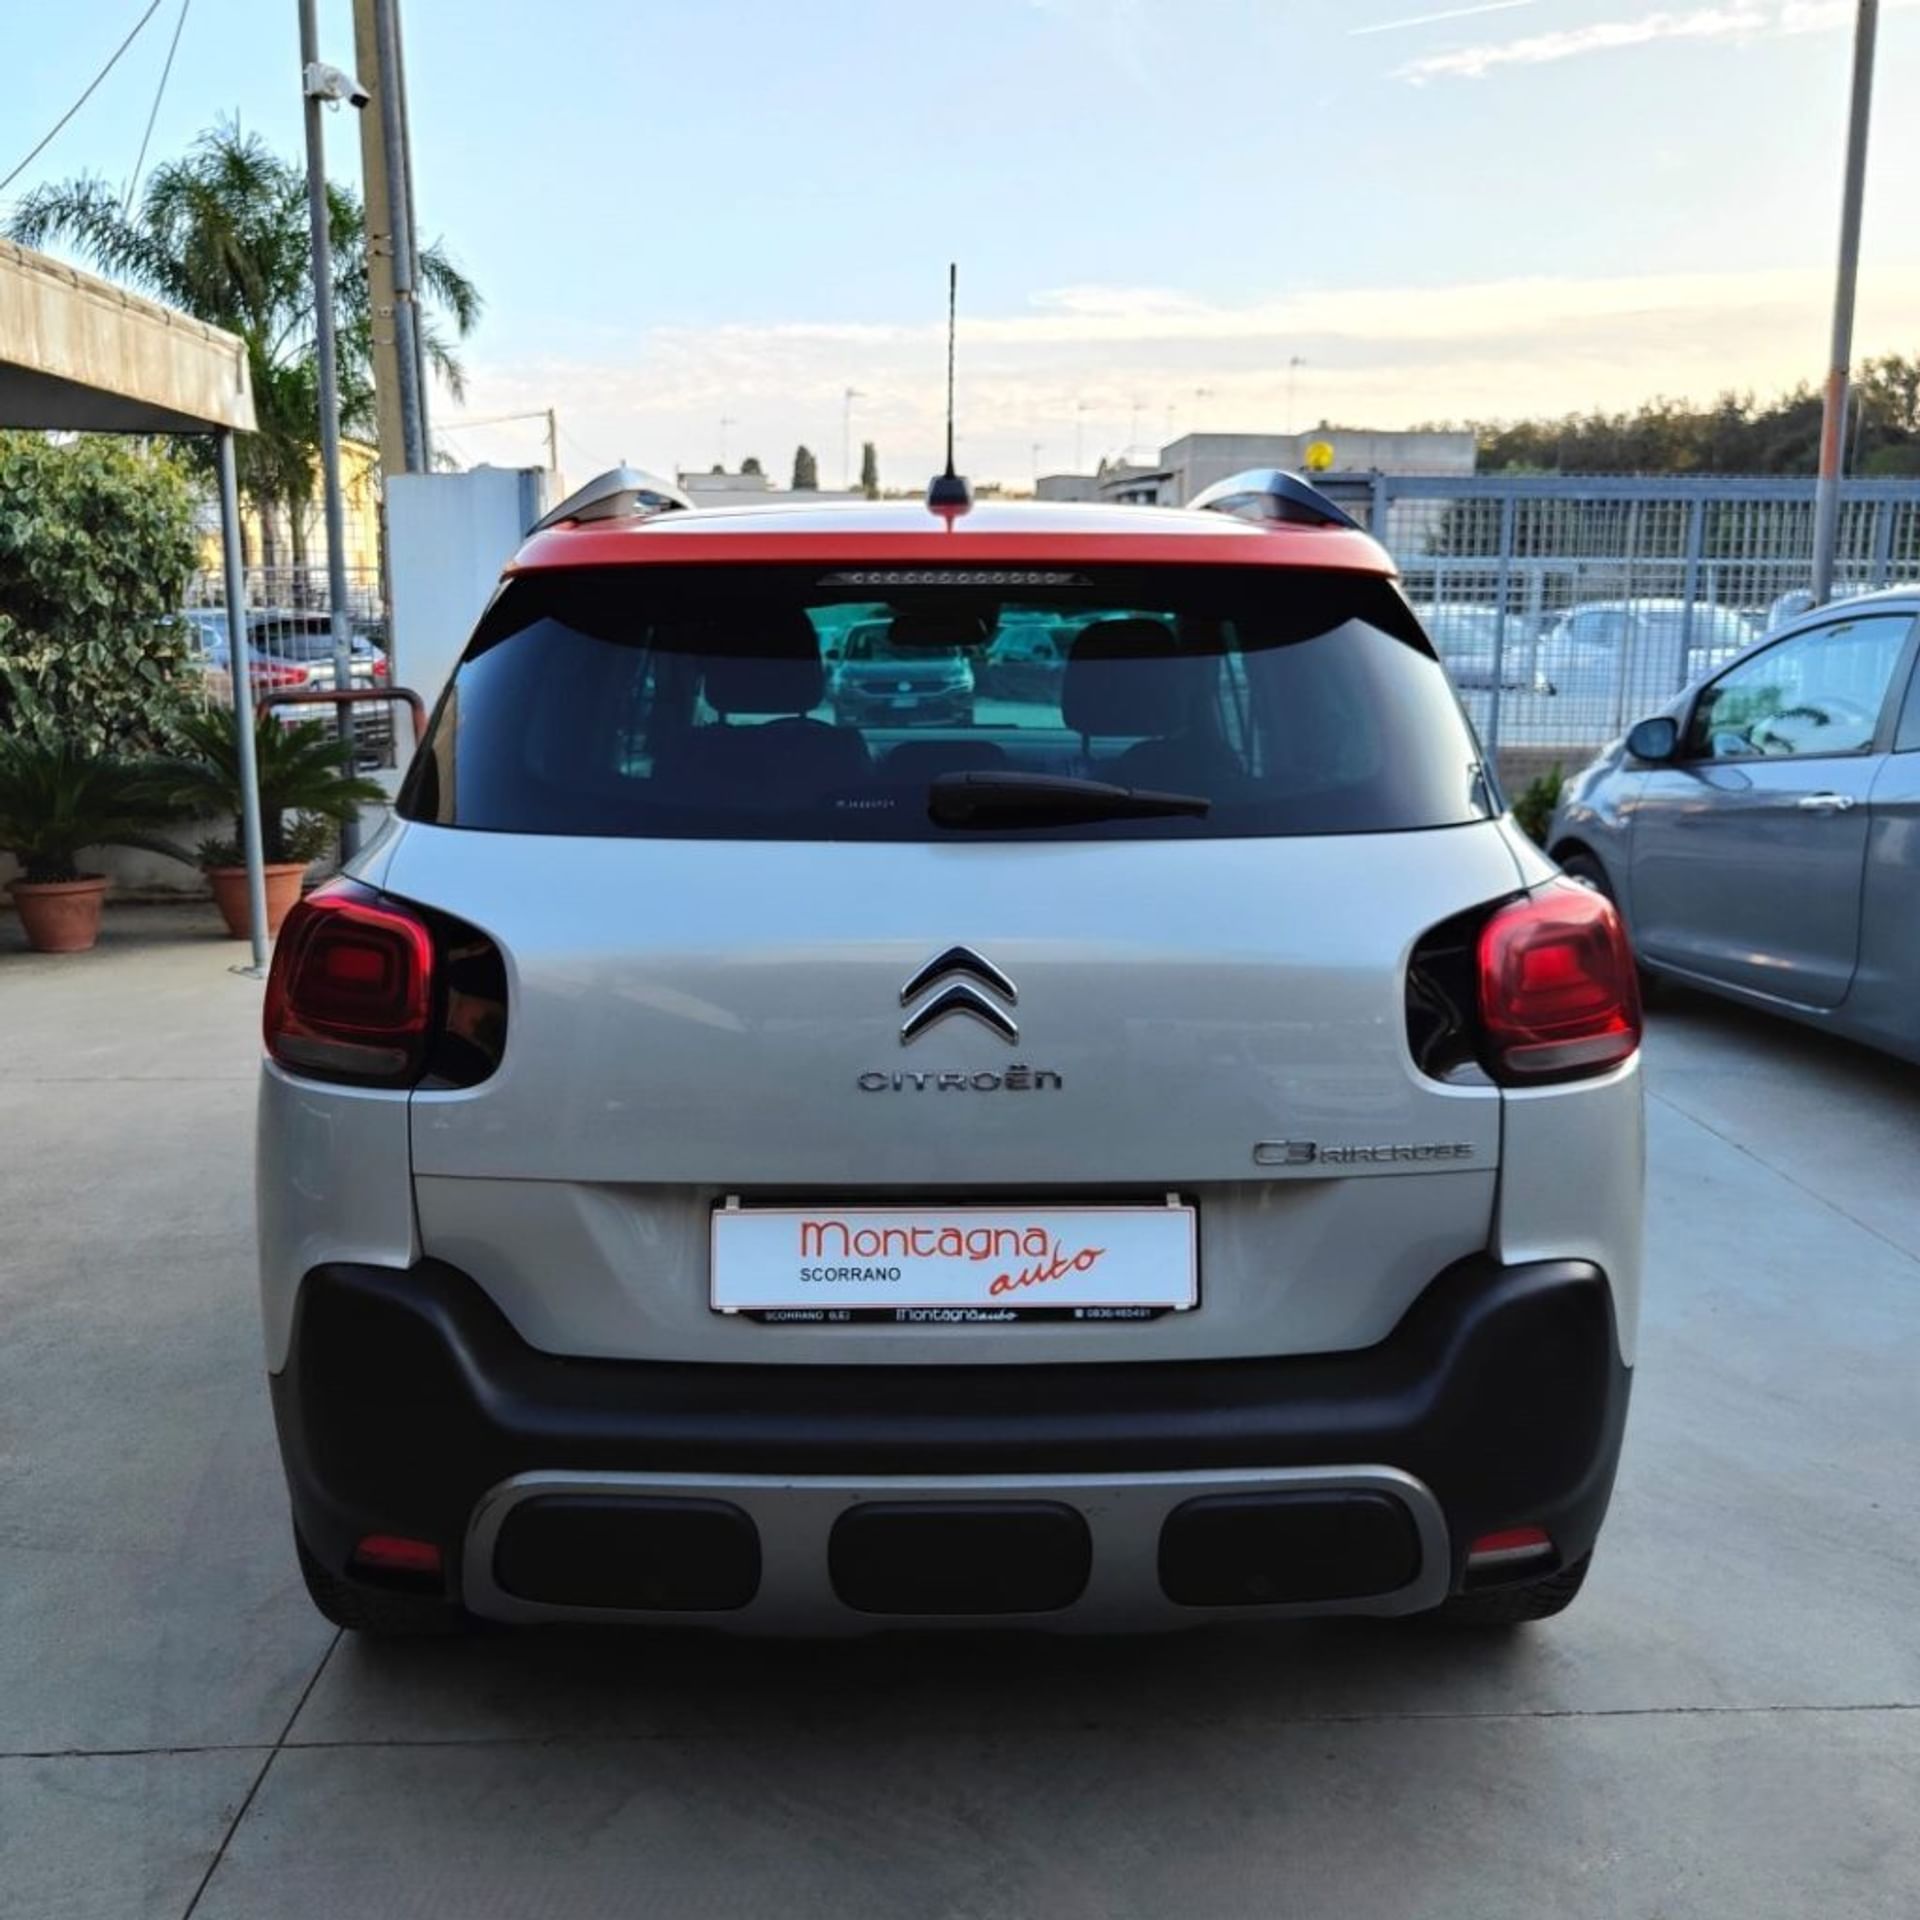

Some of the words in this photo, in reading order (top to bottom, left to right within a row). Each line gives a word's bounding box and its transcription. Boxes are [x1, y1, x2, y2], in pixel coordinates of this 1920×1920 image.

[1253, 1139, 1316, 1166] C3
[1319, 1143, 1475, 1164] AIRCROSS
[800, 1266, 901, 1282] SCORRANO
[989, 1238, 1106, 1296] auto
